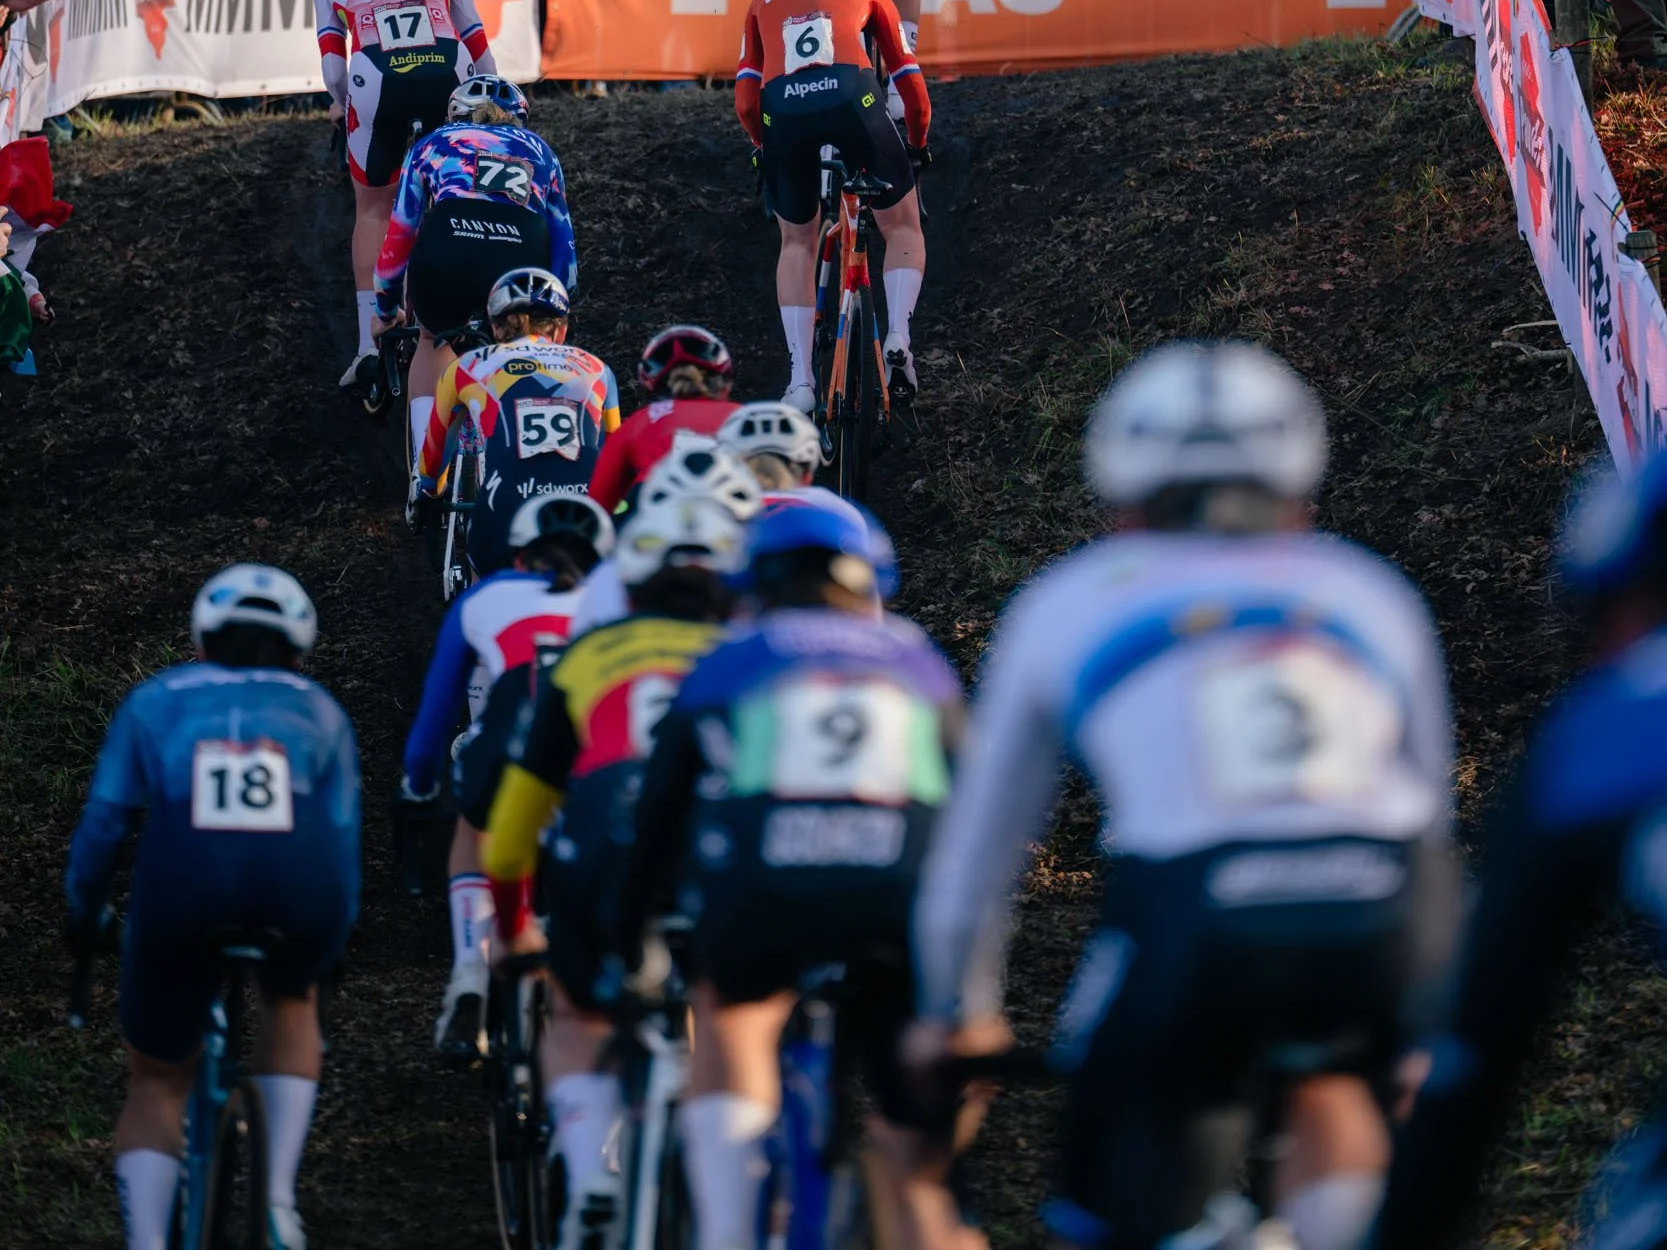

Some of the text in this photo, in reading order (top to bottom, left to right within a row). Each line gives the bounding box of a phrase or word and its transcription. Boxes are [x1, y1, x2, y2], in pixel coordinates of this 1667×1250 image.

[384, 12, 422, 40] 17
[795, 26, 820, 58] 6
[389, 52, 445, 67] Andiprim
[784, 77, 838, 98] Alpecin
[478, 160, 528, 197] 72
[450, 218, 521, 236] CANYON
[522, 413, 576, 447] 59
[818, 704, 866, 768] 9
[1253, 686, 1327, 768] 3
[210, 765, 272, 808] 18
